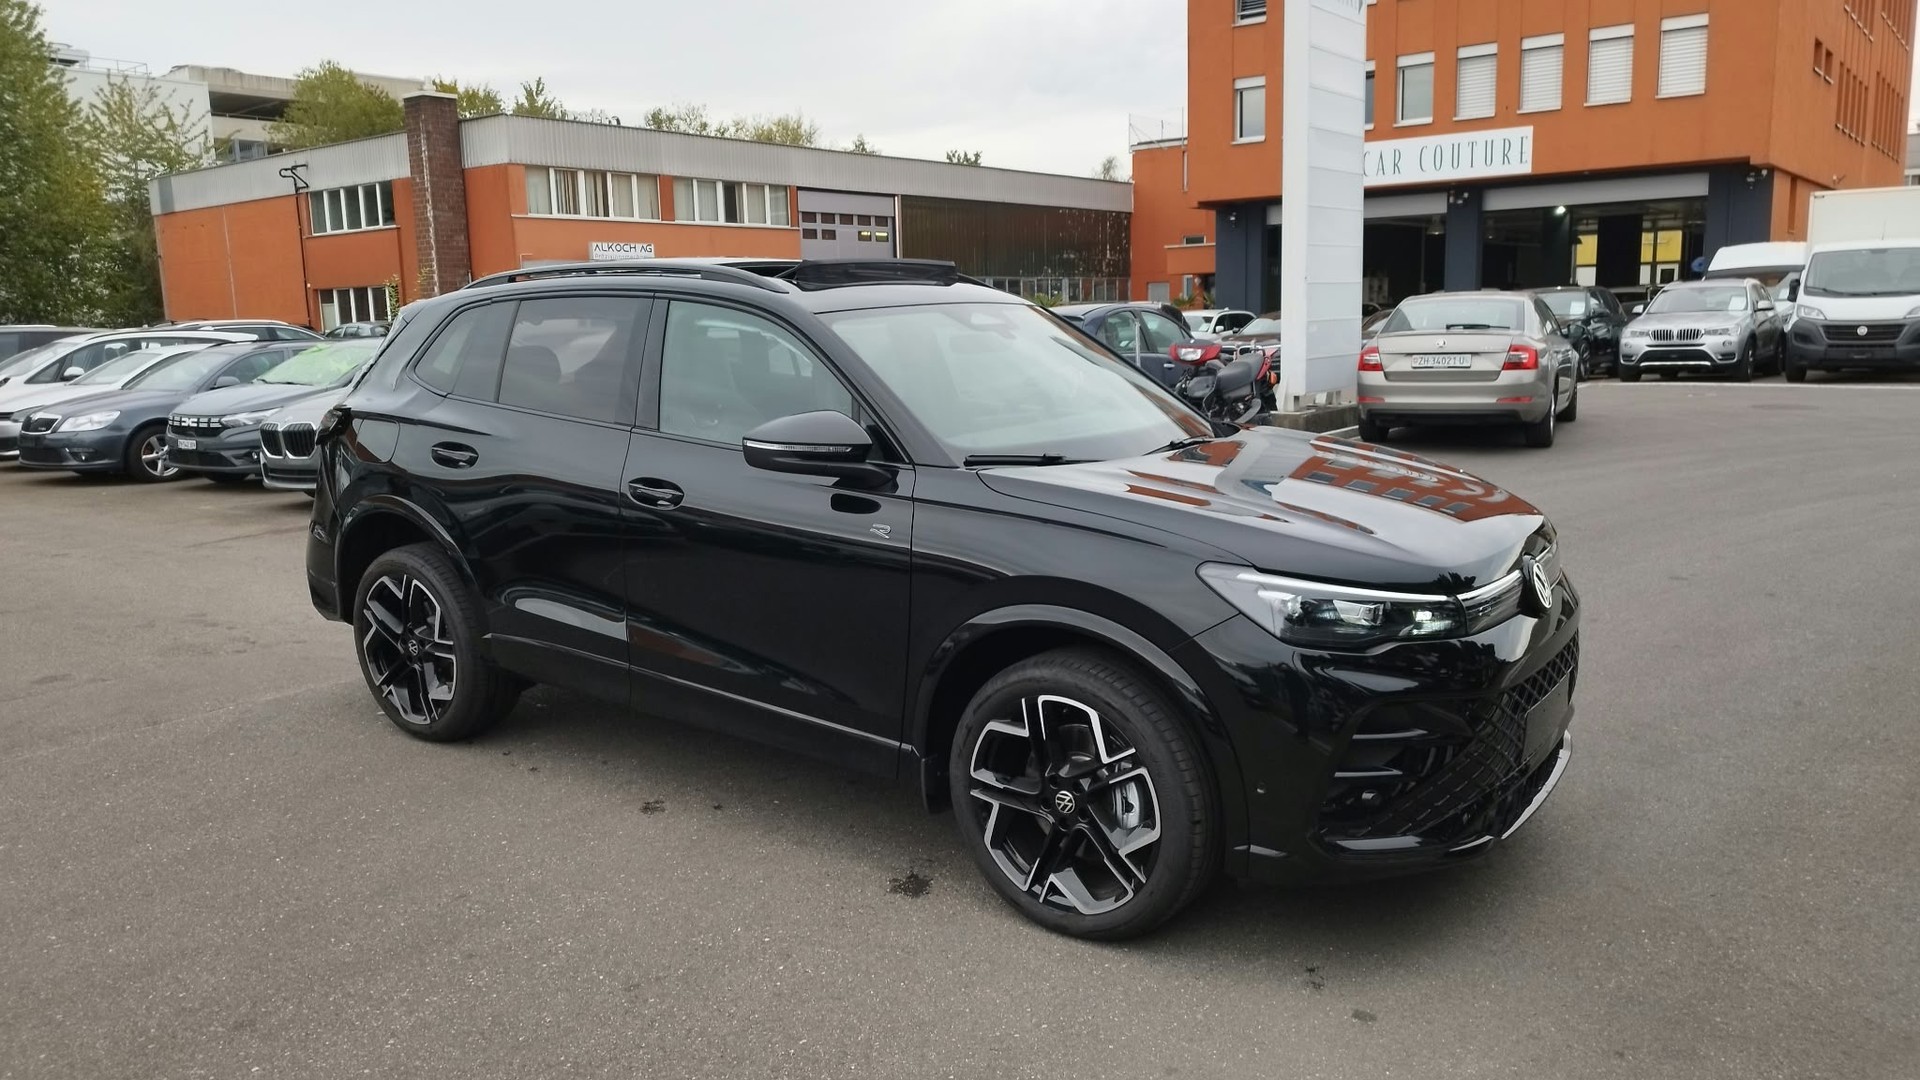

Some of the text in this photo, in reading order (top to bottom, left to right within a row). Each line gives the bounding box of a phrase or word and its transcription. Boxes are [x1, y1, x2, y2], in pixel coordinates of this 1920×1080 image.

[1363, 135, 1529, 177] CAR COUTURE
[594, 242, 653, 253] ALKOCH AG
